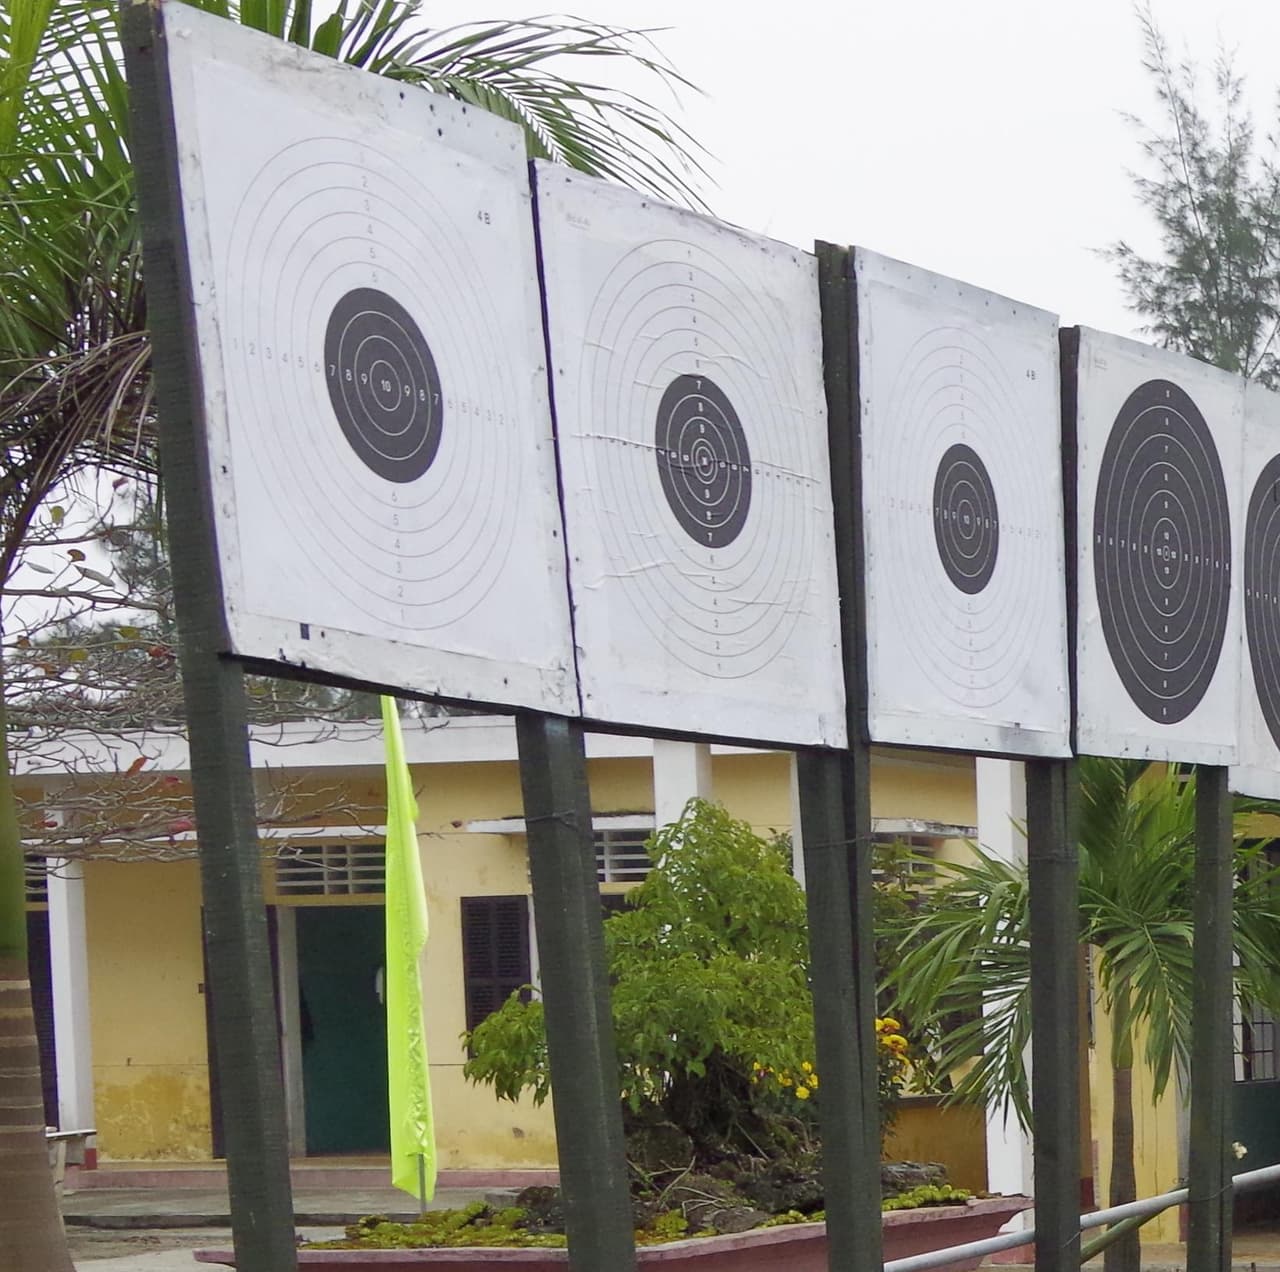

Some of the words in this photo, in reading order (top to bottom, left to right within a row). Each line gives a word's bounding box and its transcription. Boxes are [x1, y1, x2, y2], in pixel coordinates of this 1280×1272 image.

[248, 342, 257, 356] 2
[328, 363, 337, 377] 7
[345, 368, 354, 382] 8
[360, 372, 369, 385] 9
[381, 379, 393, 393] 10
[404, 384, 412, 398] 9
[419, 388, 427, 402] 8
[432, 392, 441, 406] 7
[695, 379, 703, 391] 7
[391, 490, 399, 503] 6
[392, 513, 400, 526] 5
